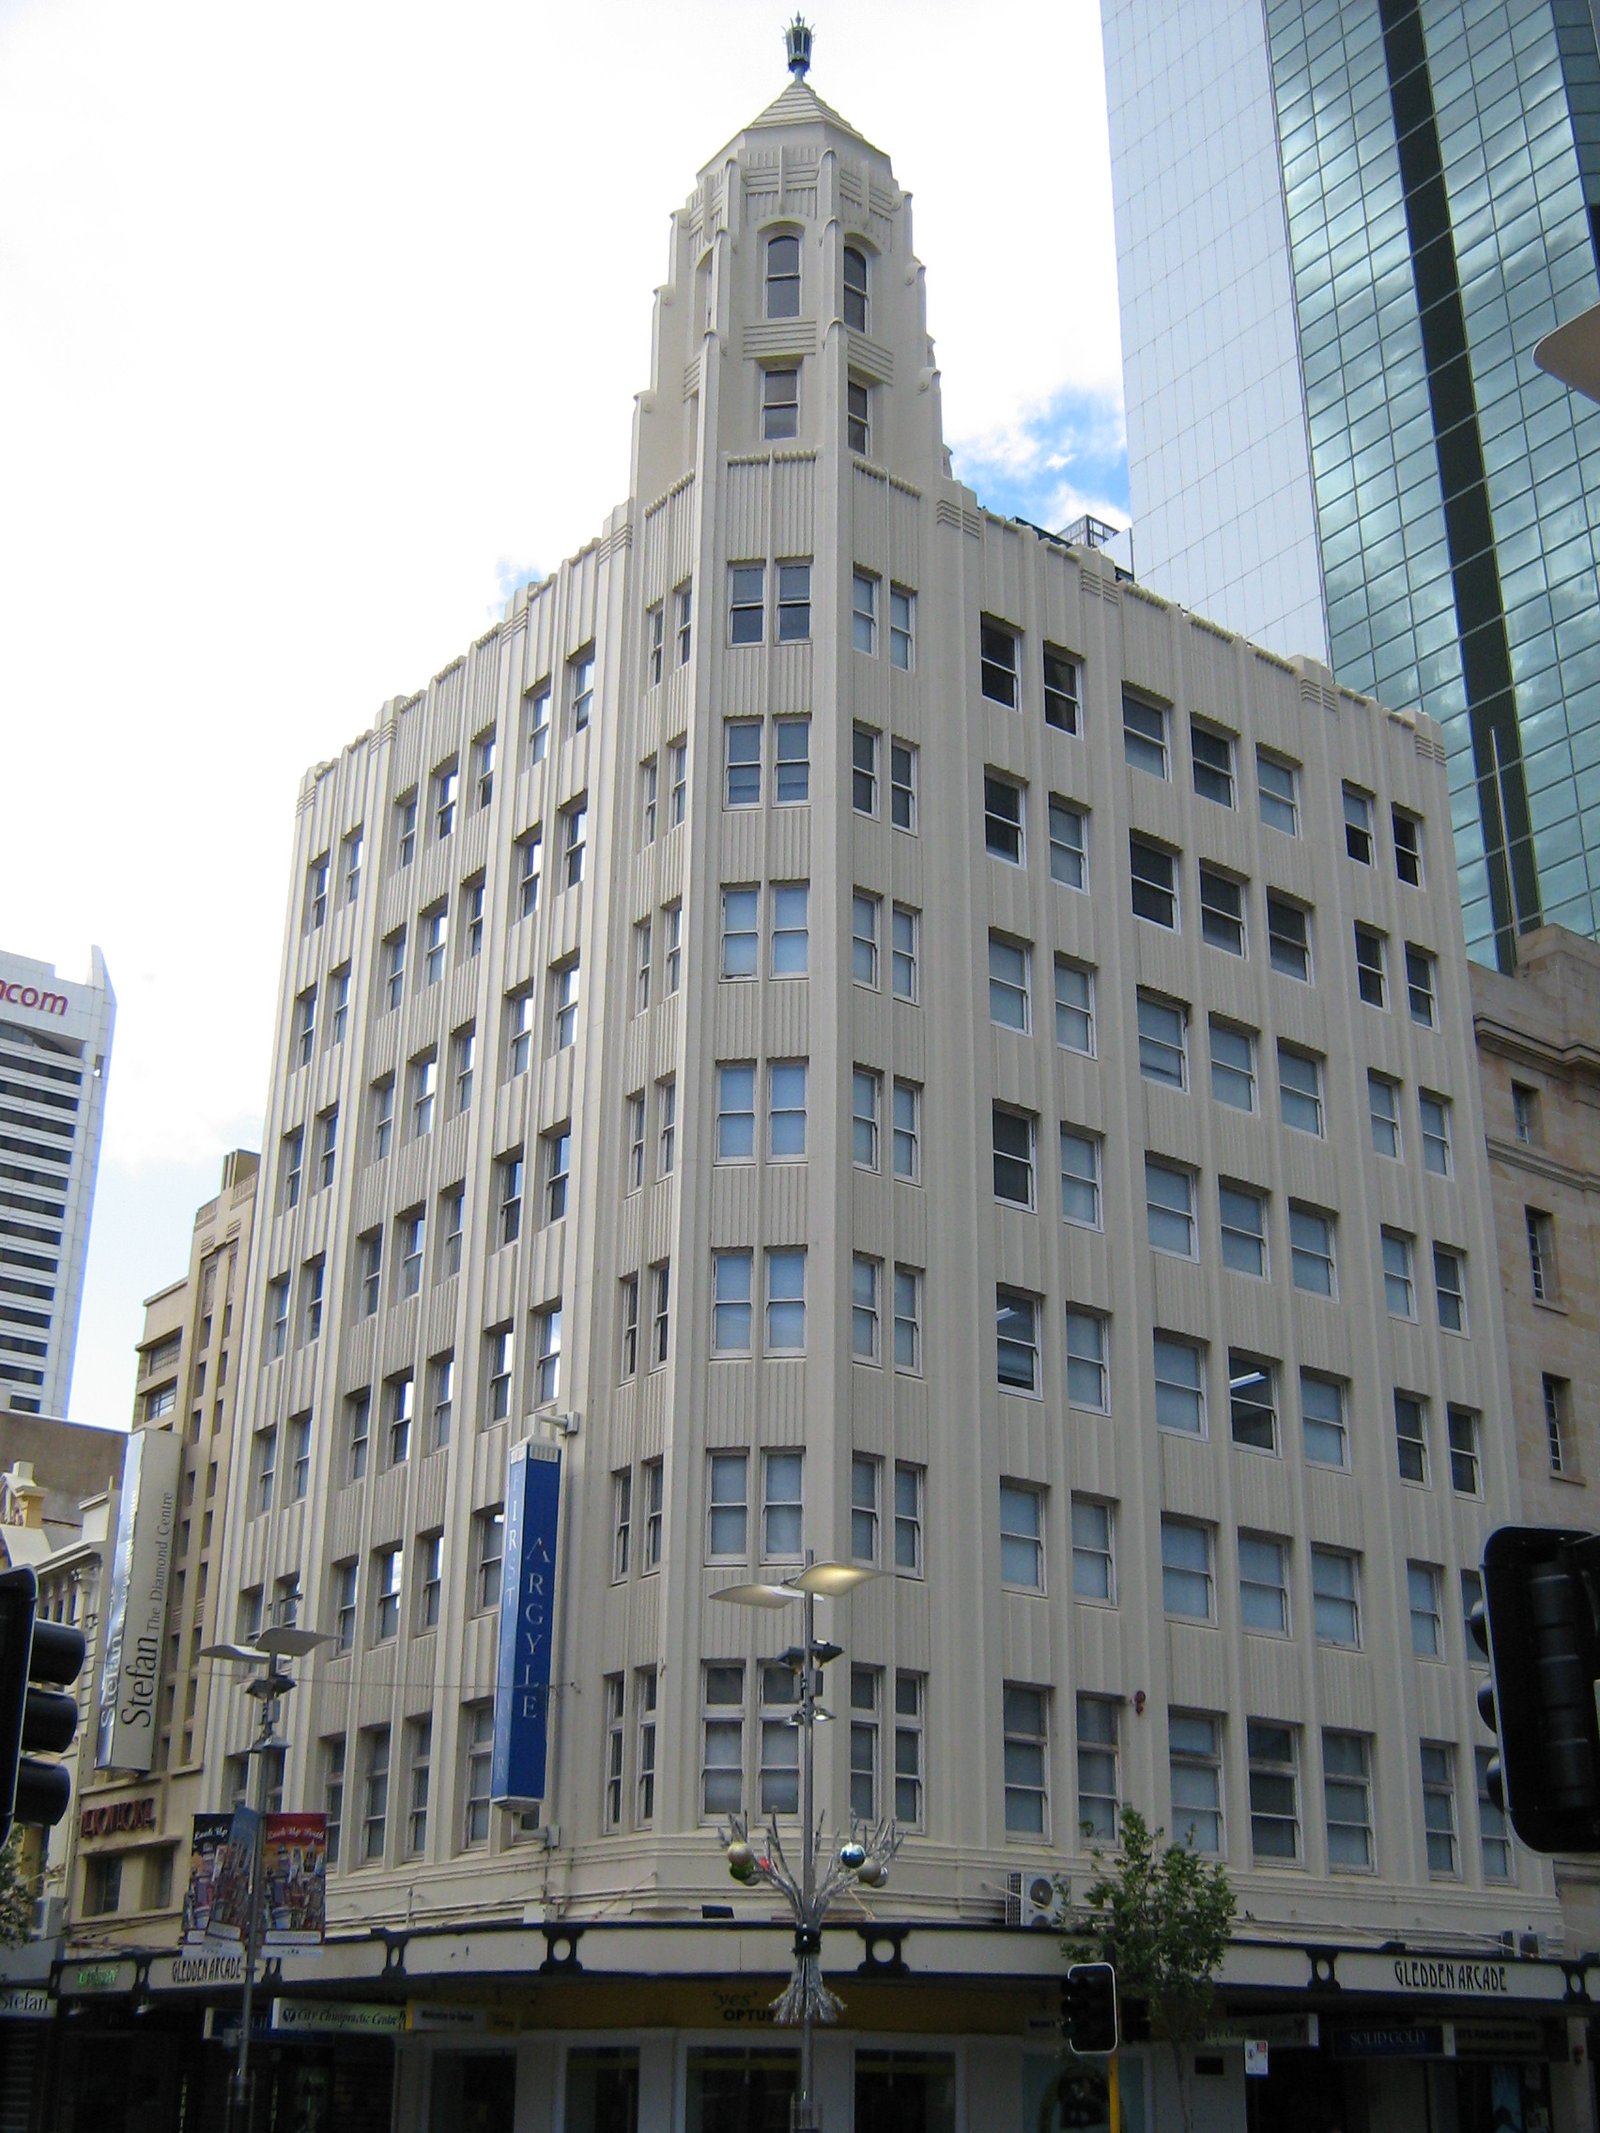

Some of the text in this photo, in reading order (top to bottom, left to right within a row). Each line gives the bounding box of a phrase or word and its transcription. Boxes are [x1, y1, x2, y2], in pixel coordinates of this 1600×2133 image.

[157, 1492, 173, 1536] Centre
[504, 1469, 521, 1605] FIRST
[150, 1540, 169, 1602] Diamond
[146, 1606, 161, 1633] The
[521, 1536, 552, 1719] ARGYLE
[120, 1636, 158, 1728] Stefan
[172, 1956, 242, 1983] GLEDDEN ARCADE
[1394, 1960, 1508, 1991] GLEDDEN ARCADE
[724, 2009, 775, 2021] OPTUS
[1350, 2029, 1427, 2046] SOLID GOLD
